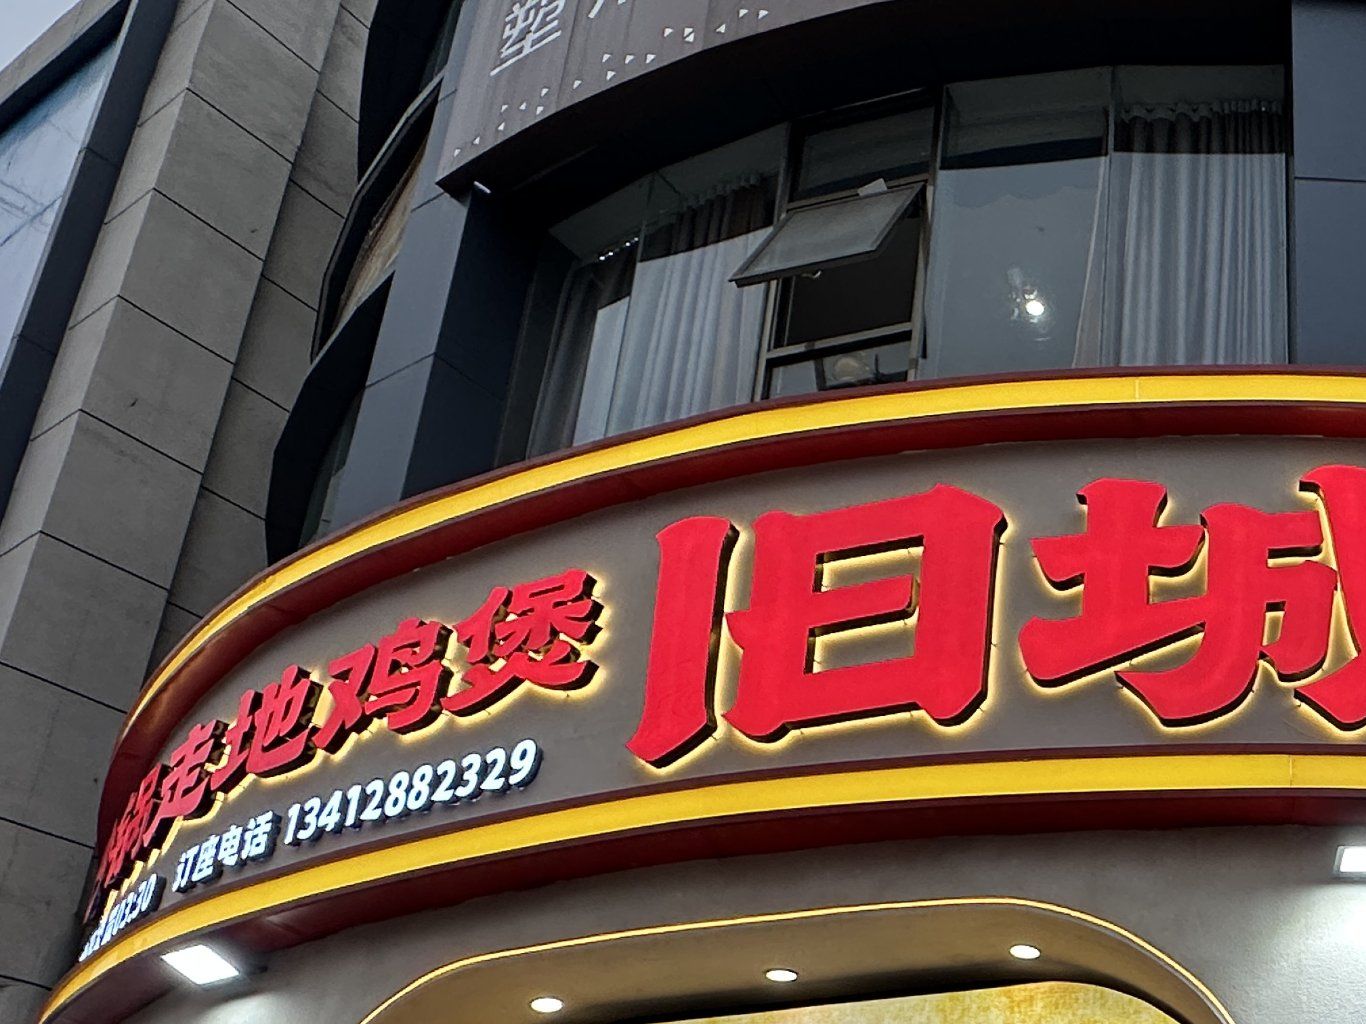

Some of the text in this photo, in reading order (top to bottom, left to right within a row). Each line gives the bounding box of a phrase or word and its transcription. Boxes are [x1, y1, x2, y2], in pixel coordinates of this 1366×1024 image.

[172, 738, 539, 892] 订座电话 13412882329
